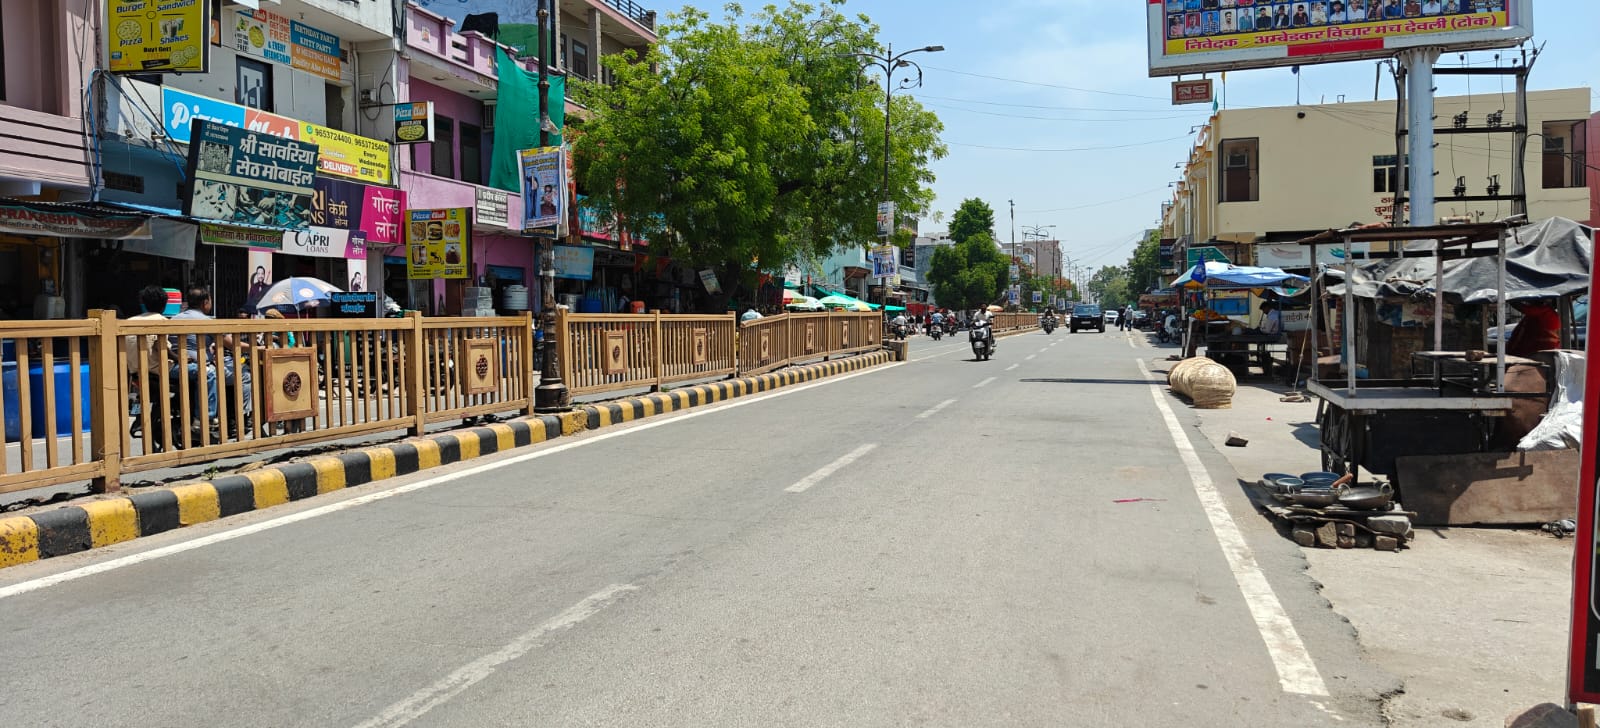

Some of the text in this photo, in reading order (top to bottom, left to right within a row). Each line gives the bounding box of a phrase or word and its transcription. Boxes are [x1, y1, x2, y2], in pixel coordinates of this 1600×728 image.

[116, 0, 196, 13] Burger Sandwich
[119, 34, 189, 47] Pizza Shakes
[294, 23, 337, 45] BIRTHDAY PARTY
[1184, 38, 1239, 51] निवेदक
[1254, 30, 1326, 47] अम्बेडकर
[1325, 25, 1371, 41] विचार
[1374, 20, 1402, 34] मंच
[1404, 17, 1447, 33] देवली
[271, 41, 286, 53] EVERY
[299, 37, 332, 54] KITTY PARTY
[263, 48, 291, 65] WEDNESDAY
[323, 55, 337, 66] HALL
[239, 134, 259, 156] श्री
[258, 140, 316, 165] सांवरिया
[235, 156, 314, 187] सेठ मोबाईल
[323, 160, 353, 174] DELIVERY
[358, 158, 387, 170] Wednesday
[371, 190, 401, 215] गोल्ड
[375, 216, 399, 240] लोन
[306, 245, 329, 254] LOANS
